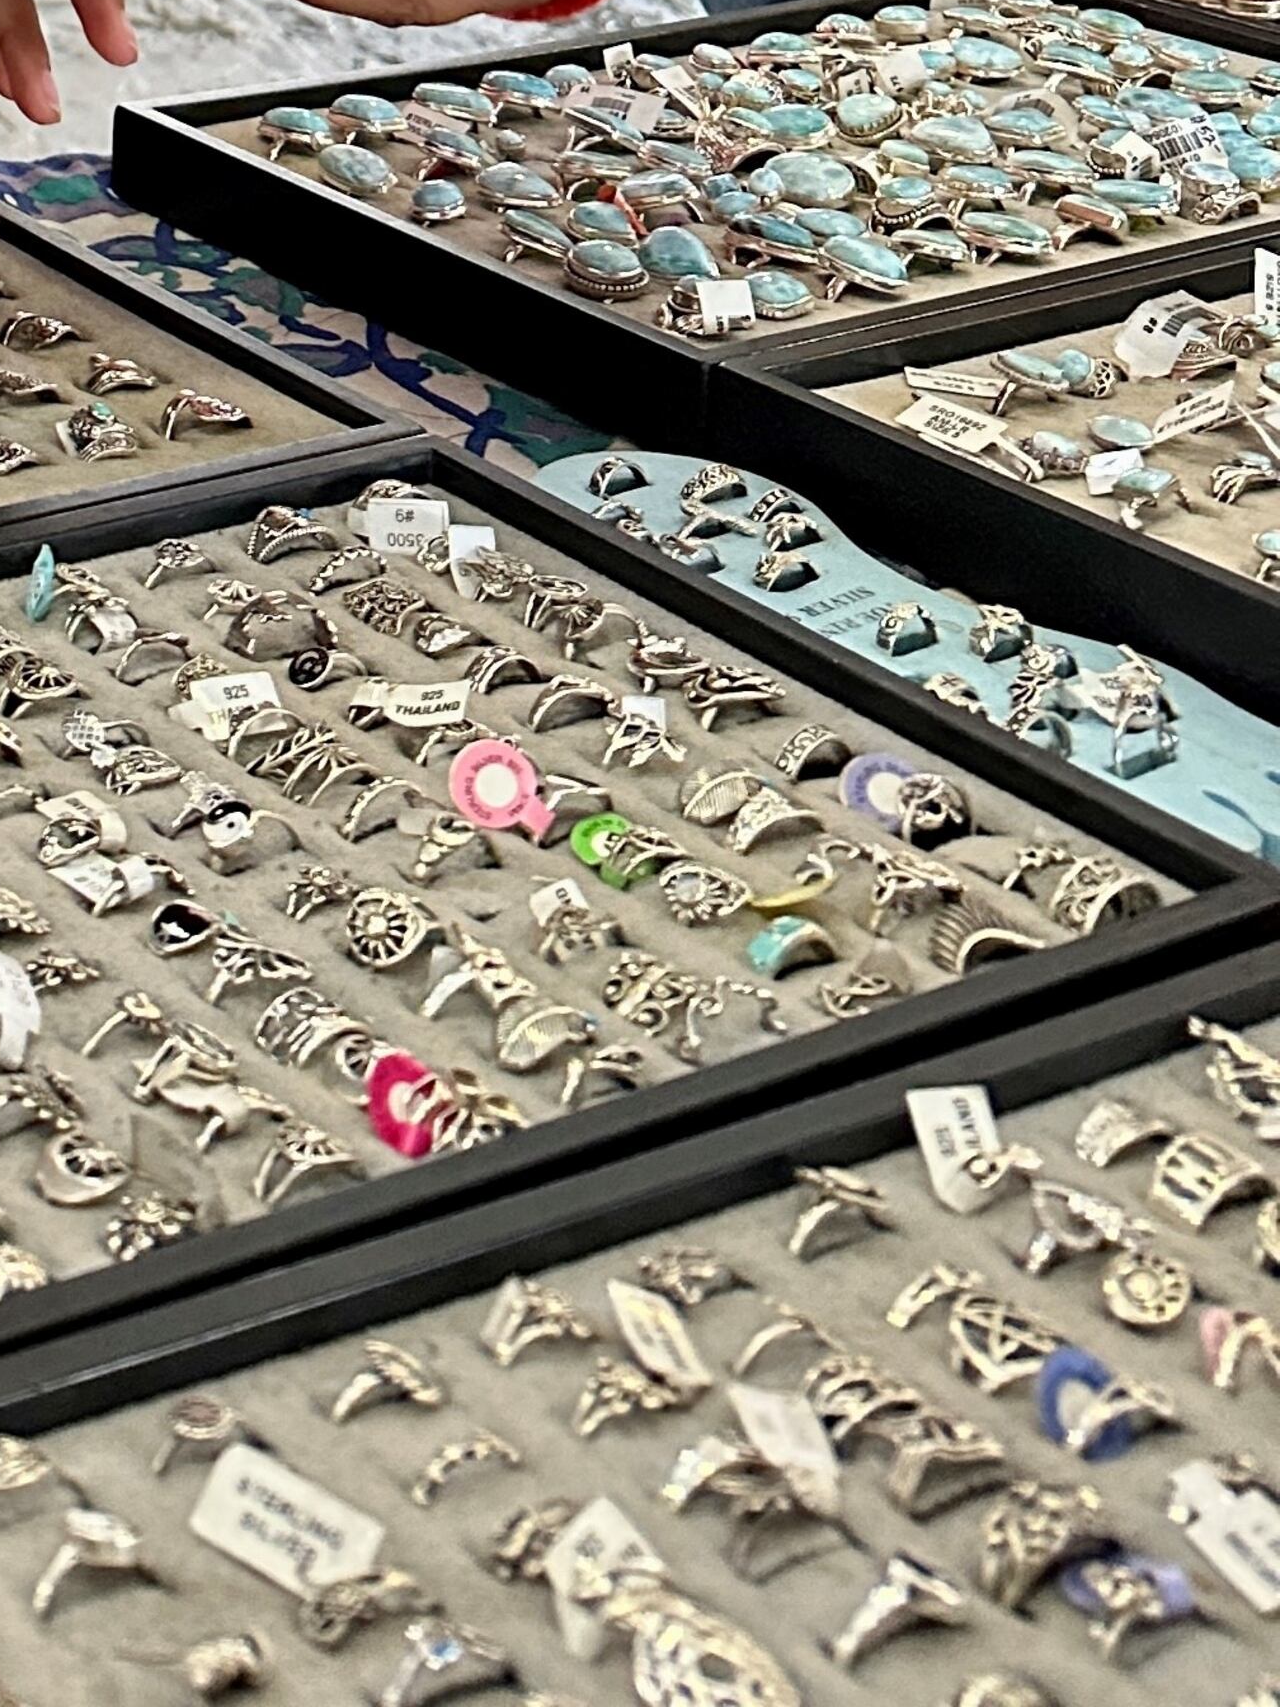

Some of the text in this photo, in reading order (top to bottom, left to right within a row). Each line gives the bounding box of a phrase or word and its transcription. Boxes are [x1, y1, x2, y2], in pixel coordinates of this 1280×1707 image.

[395, 508, 415, 523] #9
[797, 586, 876, 618] SILVER
[223, 685, 249, 700] 925
[421, 689, 444, 701] 925
[395, 700, 461, 716] THAILAND
